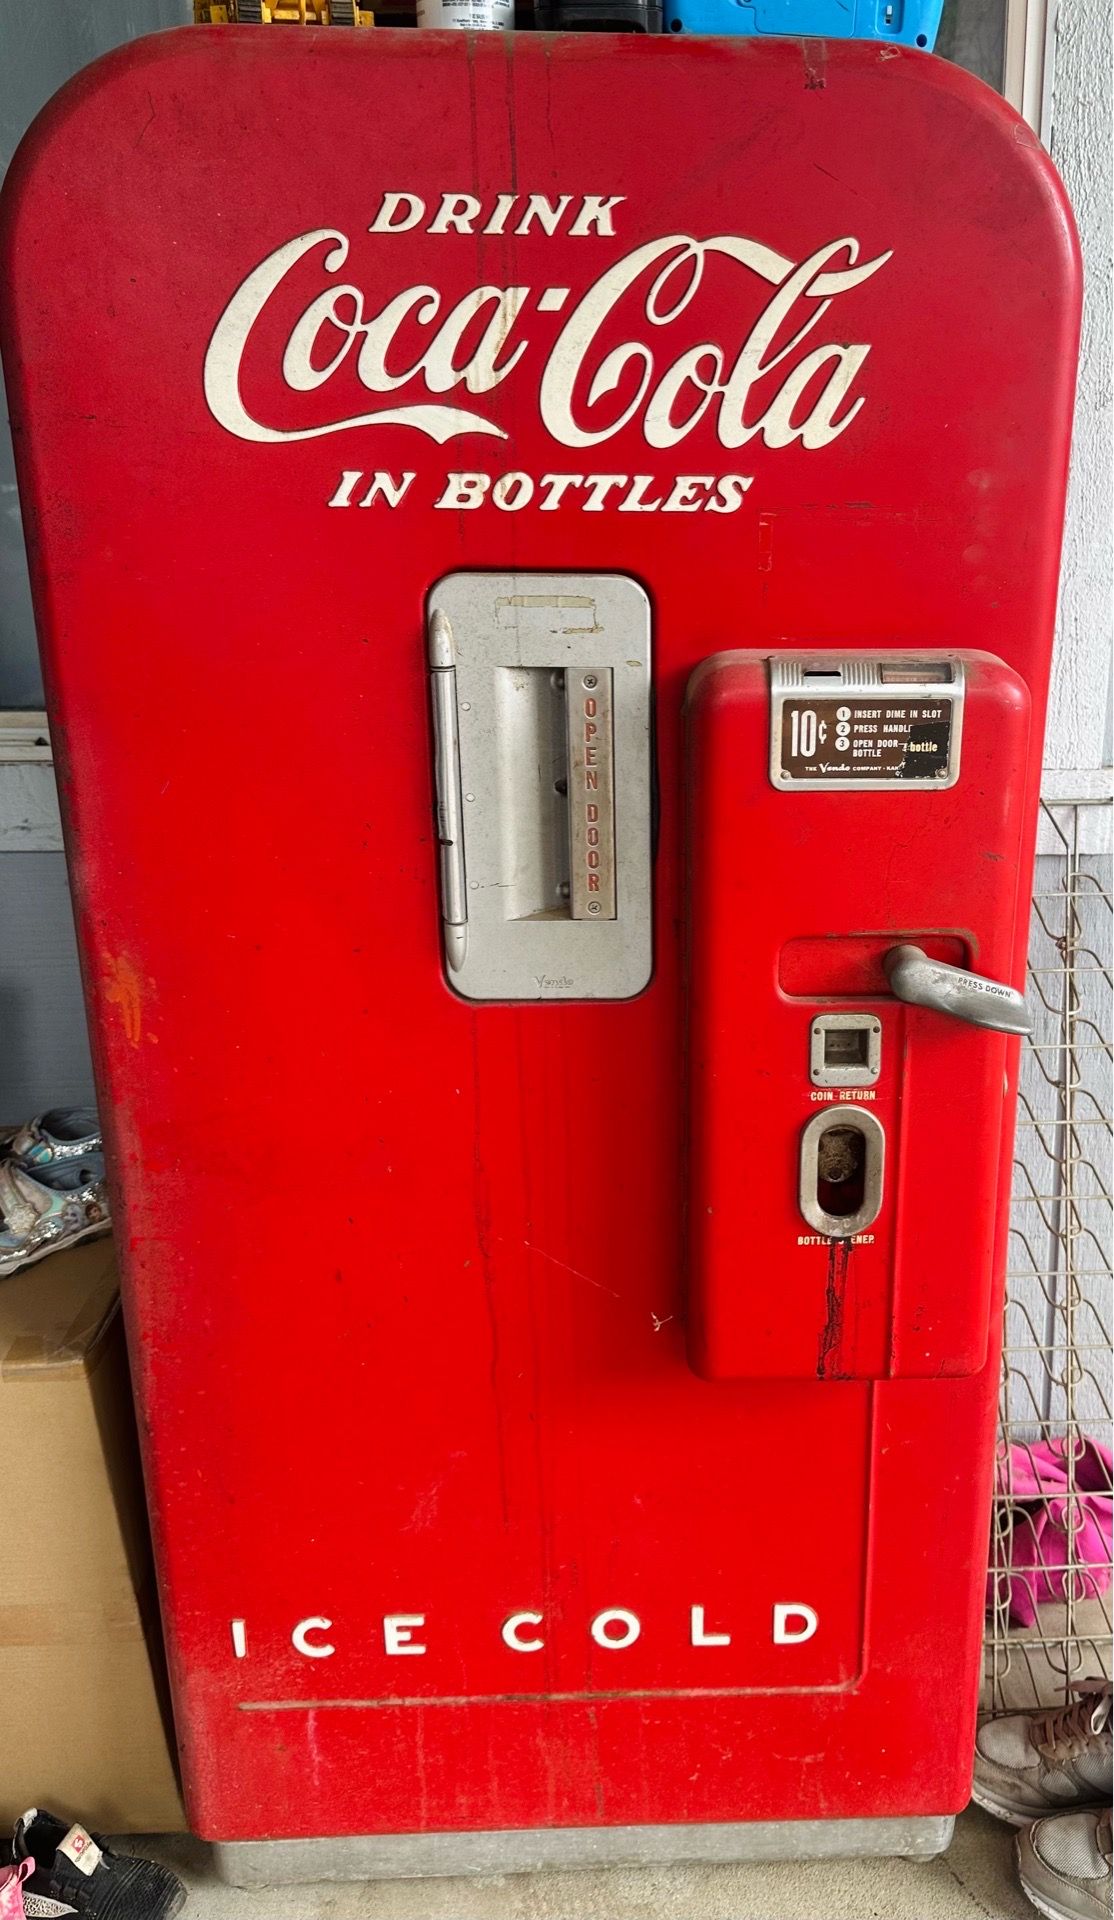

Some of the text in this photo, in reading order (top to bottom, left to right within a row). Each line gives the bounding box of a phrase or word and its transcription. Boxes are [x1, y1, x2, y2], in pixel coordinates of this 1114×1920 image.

[368, 192, 626, 236] DRINK
[204, 229, 894, 449] Coca-Cola
[328, 470, 754, 514] IN BOTTLES
[854, 710, 882, 719] INSERT
[886, 710, 906, 719] DIME
[910, 710, 918, 718] IN
[922, 709, 942, 719] SLOT
[791, 709, 828, 758] 10¢
[853, 724, 878, 733] PRESS
[584, 697, 598, 790] OPEN
[853, 739, 873, 748] OPEN
[910, 741, 938, 752] bottle
[852, 748, 882, 758] BOTTLE
[819, 762, 850, 774] Vendo
[586, 803, 600, 892] DOOR
[534, 974, 575, 988] Vendo
[957, 977, 1011, 998] PRESS DOWN
[810, 1090, 876, 1102] COIN RETURN
[797, 1235, 832, 1246] BOTTLE
[231, 1603, 818, 1659] ICE COLD
